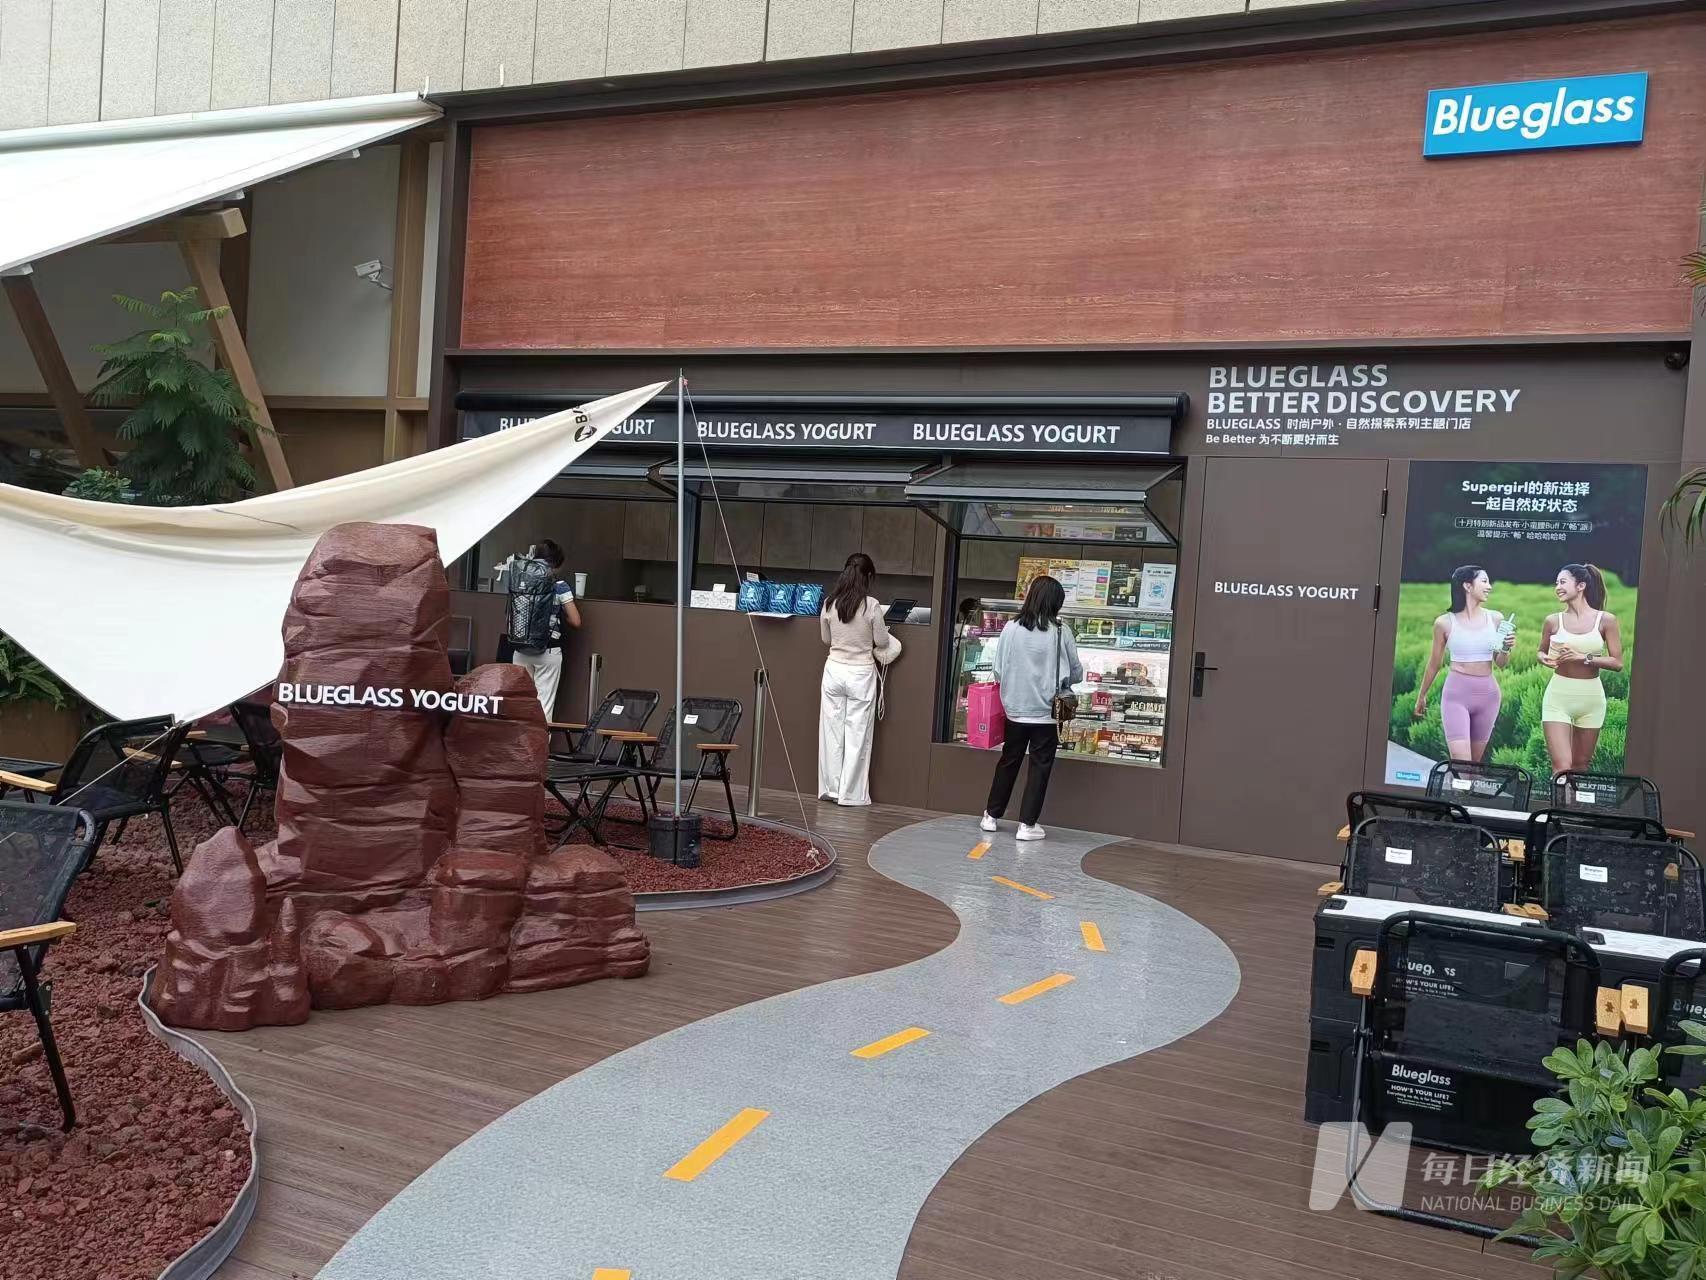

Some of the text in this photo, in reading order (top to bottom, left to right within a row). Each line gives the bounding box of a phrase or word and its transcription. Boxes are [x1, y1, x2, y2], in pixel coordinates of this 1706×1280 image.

[1432, 86, 1636, 140] Blueglass
[1209, 364, 1389, 388] BLUEGLASS
[1207, 388, 1521, 414] BETTER DISCOVERY
[697, 421, 876, 440] BLUEGLASS YOGURT
[913, 423, 1121, 444] BLUEGLASS YOGURT
[1206, 418, 1281, 430] BLUEGLASS
[1205, 433, 1340, 446] Be Better 为不断更好而生
[1461, 480, 1590, 496] Supergirl的新选择
[1471, 497, 1578, 513] 一起自然好状态
[1214, 581, 1359, 600] BLUEGLASS YOGURT
[278, 682, 504, 715] BLUEGLASS YOGURT
[1391, 1063, 1452, 1085] Blueglass
[1390, 1084, 1450, 1101] HOW'S YOUR LIFE?
